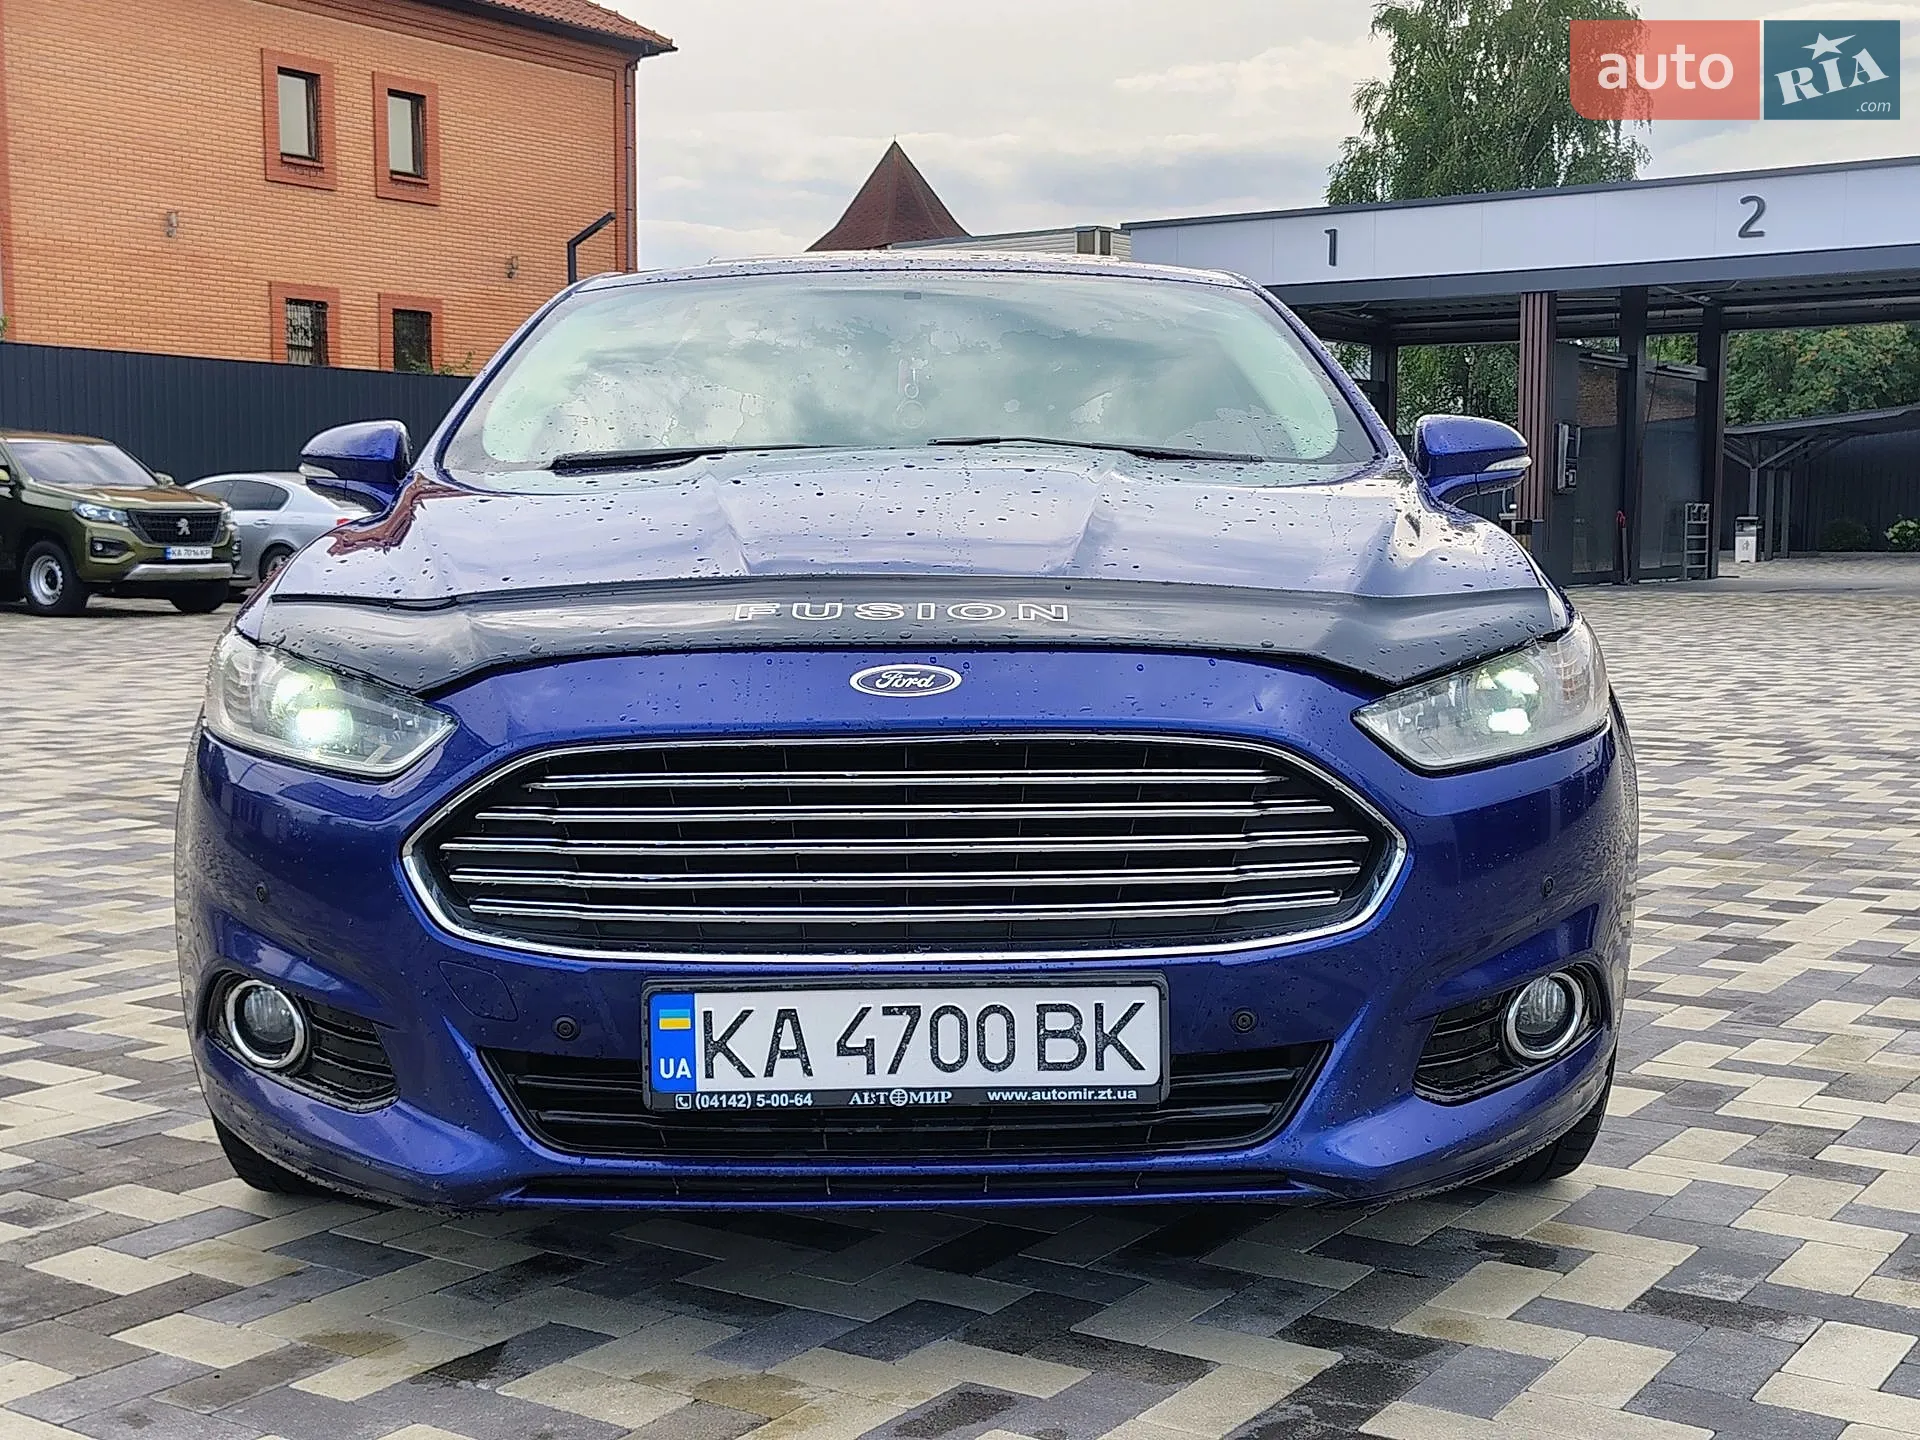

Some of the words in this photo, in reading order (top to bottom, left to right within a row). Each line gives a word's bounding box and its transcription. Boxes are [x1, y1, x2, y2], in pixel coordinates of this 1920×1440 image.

[1738, 195, 1766, 238] 2
[1324, 228, 1338, 267] 1
[735, 602, 1070, 622] FUSION
[875, 670, 935, 690] Ford
[703, 1008, 814, 1079] KA
[836, 1003, 1015, 1076] 4700
[1036, 1002, 1146, 1073] BK
[660, 1057, 692, 1080] UA
[695, 1092, 751, 1109] (04142)
[756, 1093, 813, 1107] 5-00-64
[987, 1087, 1138, 1102] www.automir.zt.ua
